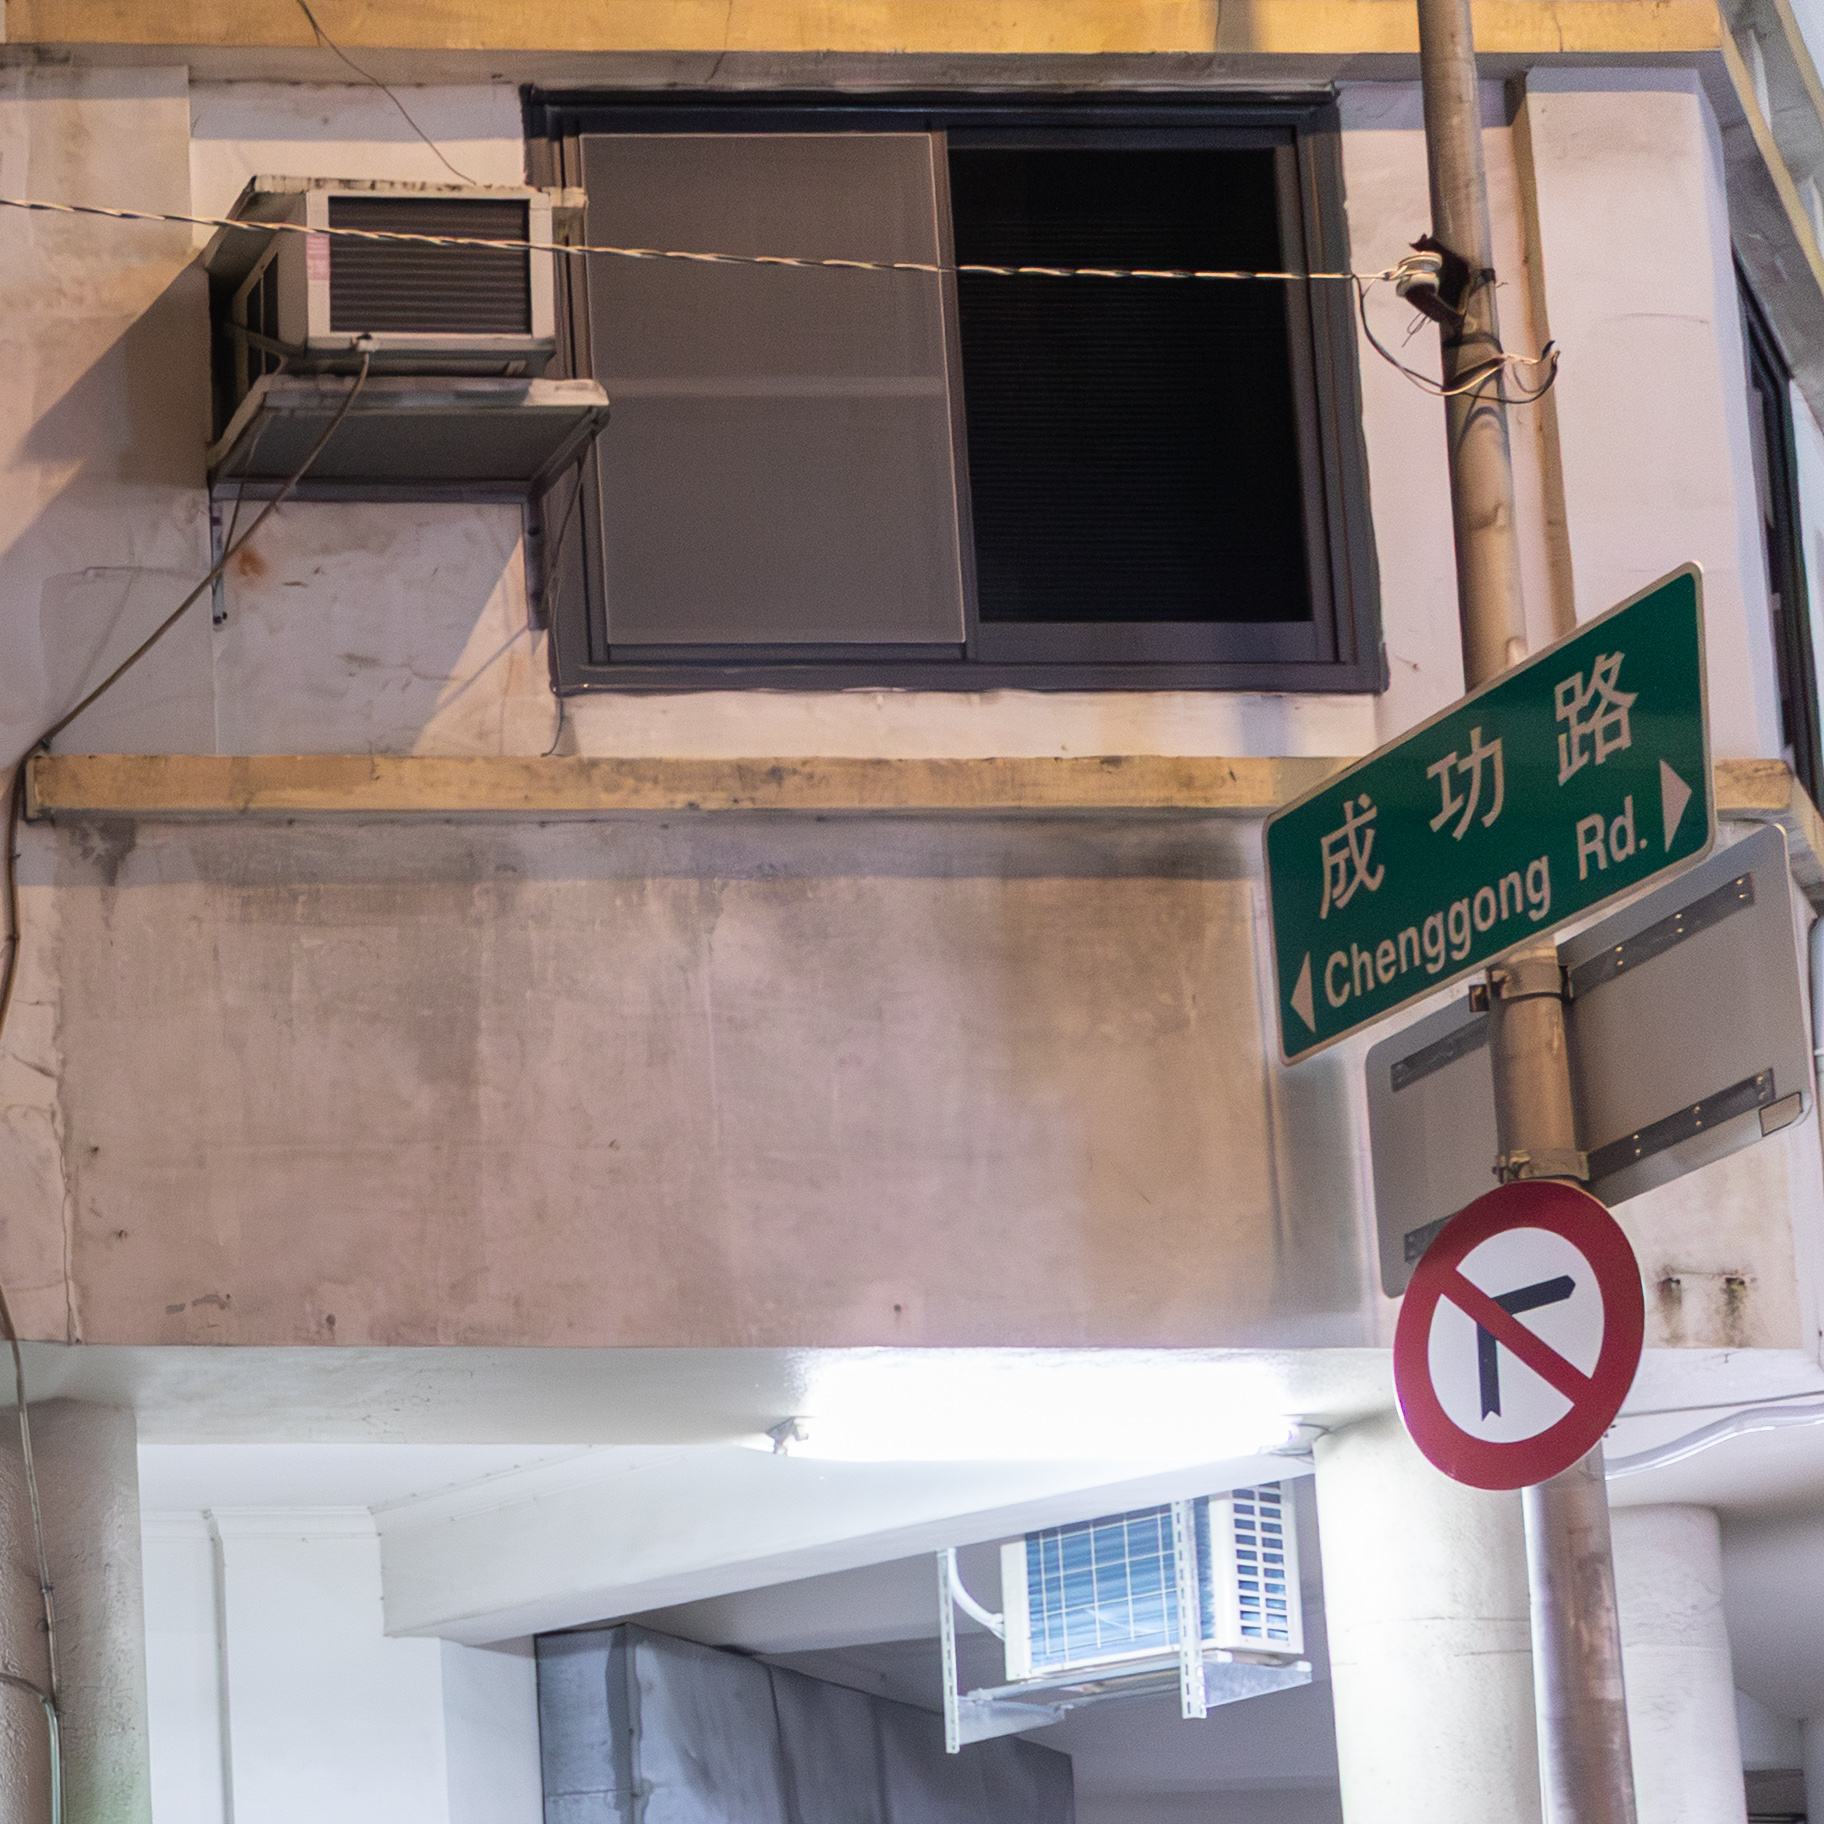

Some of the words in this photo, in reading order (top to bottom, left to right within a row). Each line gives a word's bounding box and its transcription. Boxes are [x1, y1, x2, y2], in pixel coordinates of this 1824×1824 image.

[1319, 650, 1639, 920] 成功路
[1323, 855, 1552, 1008] Chenggong
[1576, 793, 1649, 883] Rd.
